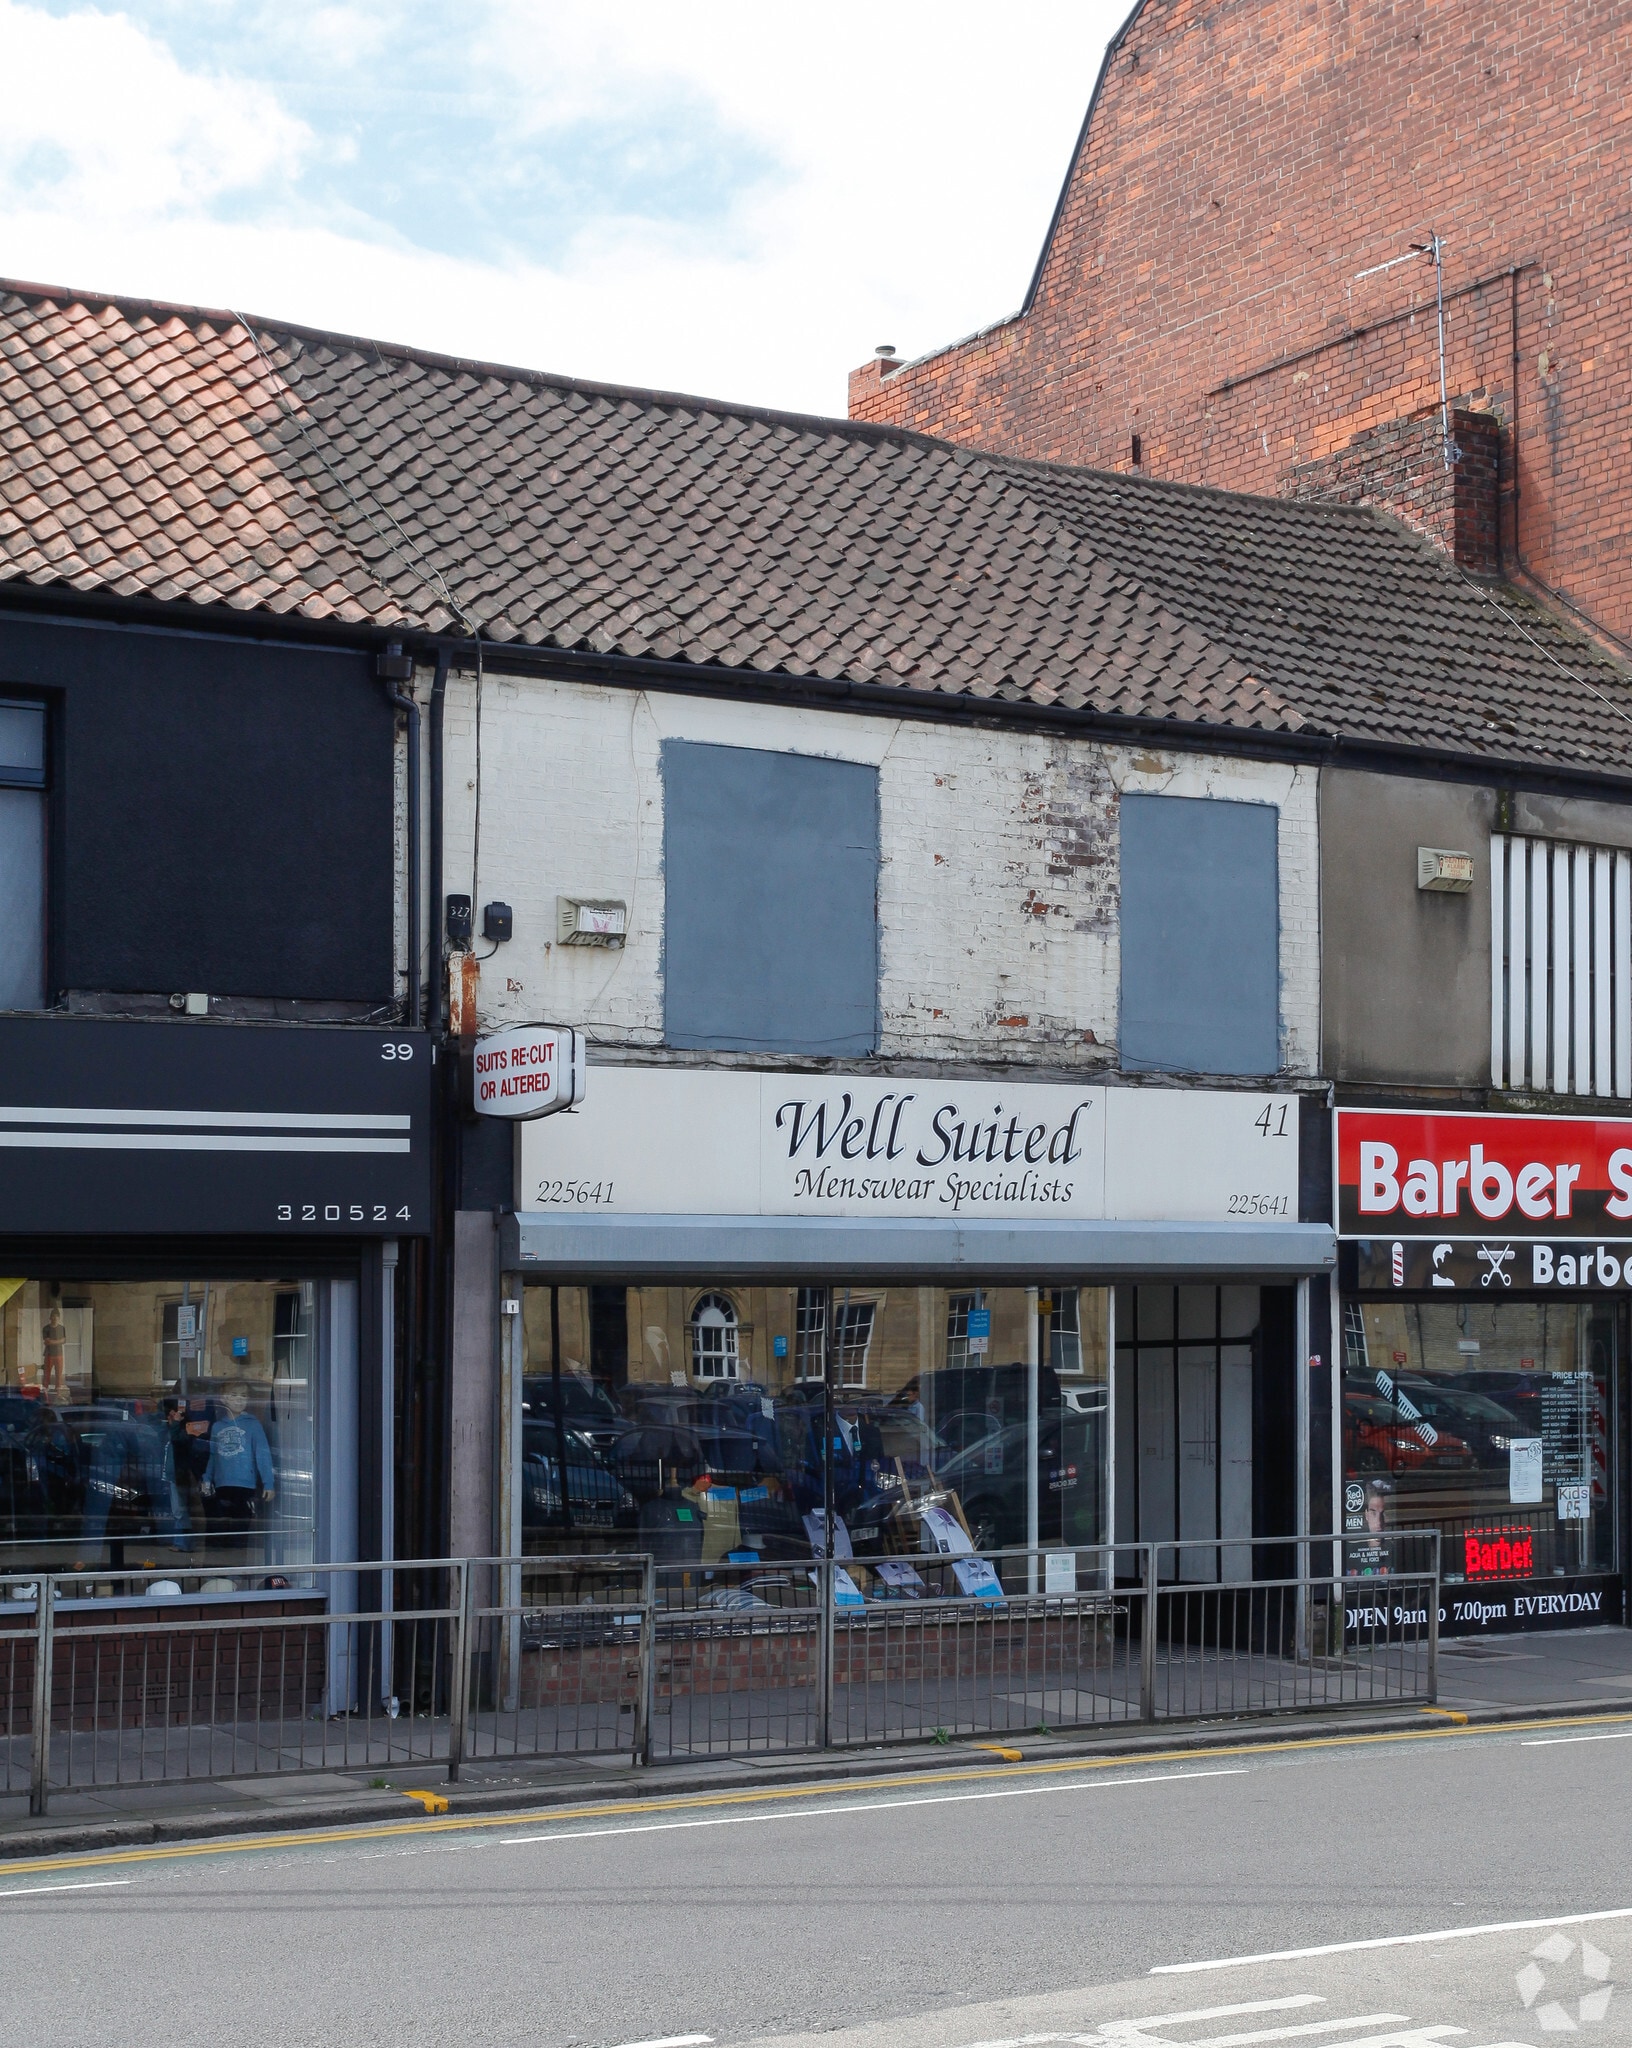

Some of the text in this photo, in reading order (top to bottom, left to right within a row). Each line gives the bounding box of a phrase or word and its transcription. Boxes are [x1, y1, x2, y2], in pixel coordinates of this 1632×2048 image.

[381, 1043, 414, 1061] 39
[476, 1049, 508, 1074] SUITS
[480, 1071, 551, 1101] OR ALTERED
[776, 1091, 1093, 1168] Well Suited
[1254, 1102, 1289, 1137] 41
[794, 1166, 1074, 1212] Menswear Specialists
[1359, 1140, 1581, 1219] Barber
[536, 1180, 615, 1204] 225641
[277, 1204, 412, 1221] 320524
[1227, 1194, 1289, 1215] 225641
[1552, 1371, 1588, 1379] PRICE LIST
[1346, 1490, 1361, 1500] Red
[1346, 1498, 1362, 1510] One
[1559, 1487, 1588, 1501] Kids
[1565, 1500, 1581, 1519] £5
[1345, 1518, 1363, 1527] MEN
[1466, 1536, 1531, 1572] Barber
[1394, 1606, 1427, 1626] 9am
[1453, 1601, 1507, 1626] 7.00pm
[1514, 1591, 1602, 1617] EVERYDAY
